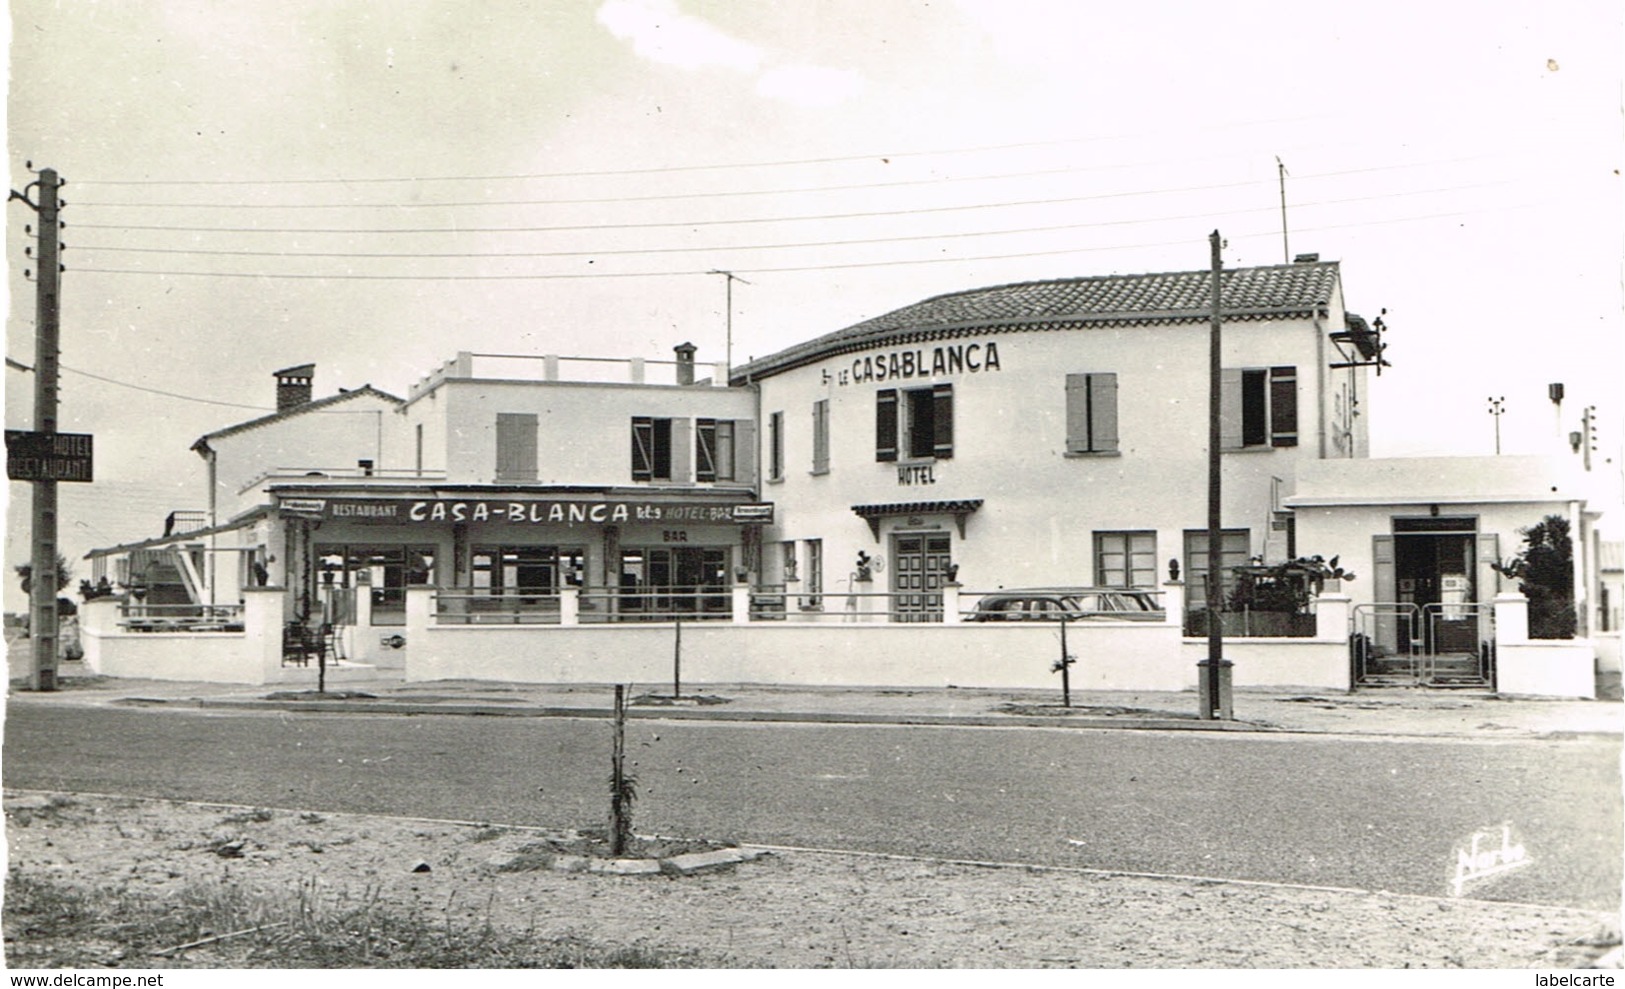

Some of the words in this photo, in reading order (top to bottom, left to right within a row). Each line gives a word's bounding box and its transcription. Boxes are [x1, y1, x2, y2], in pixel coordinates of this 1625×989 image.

[852, 342, 1001, 383] CASABLANCA
[897, 465, 936, 485] HOTEL
[332, 503, 398, 516] RESTAURANT
[409, 502, 629, 522] CASA-BLANCA
[662, 530, 688, 542] BAR
